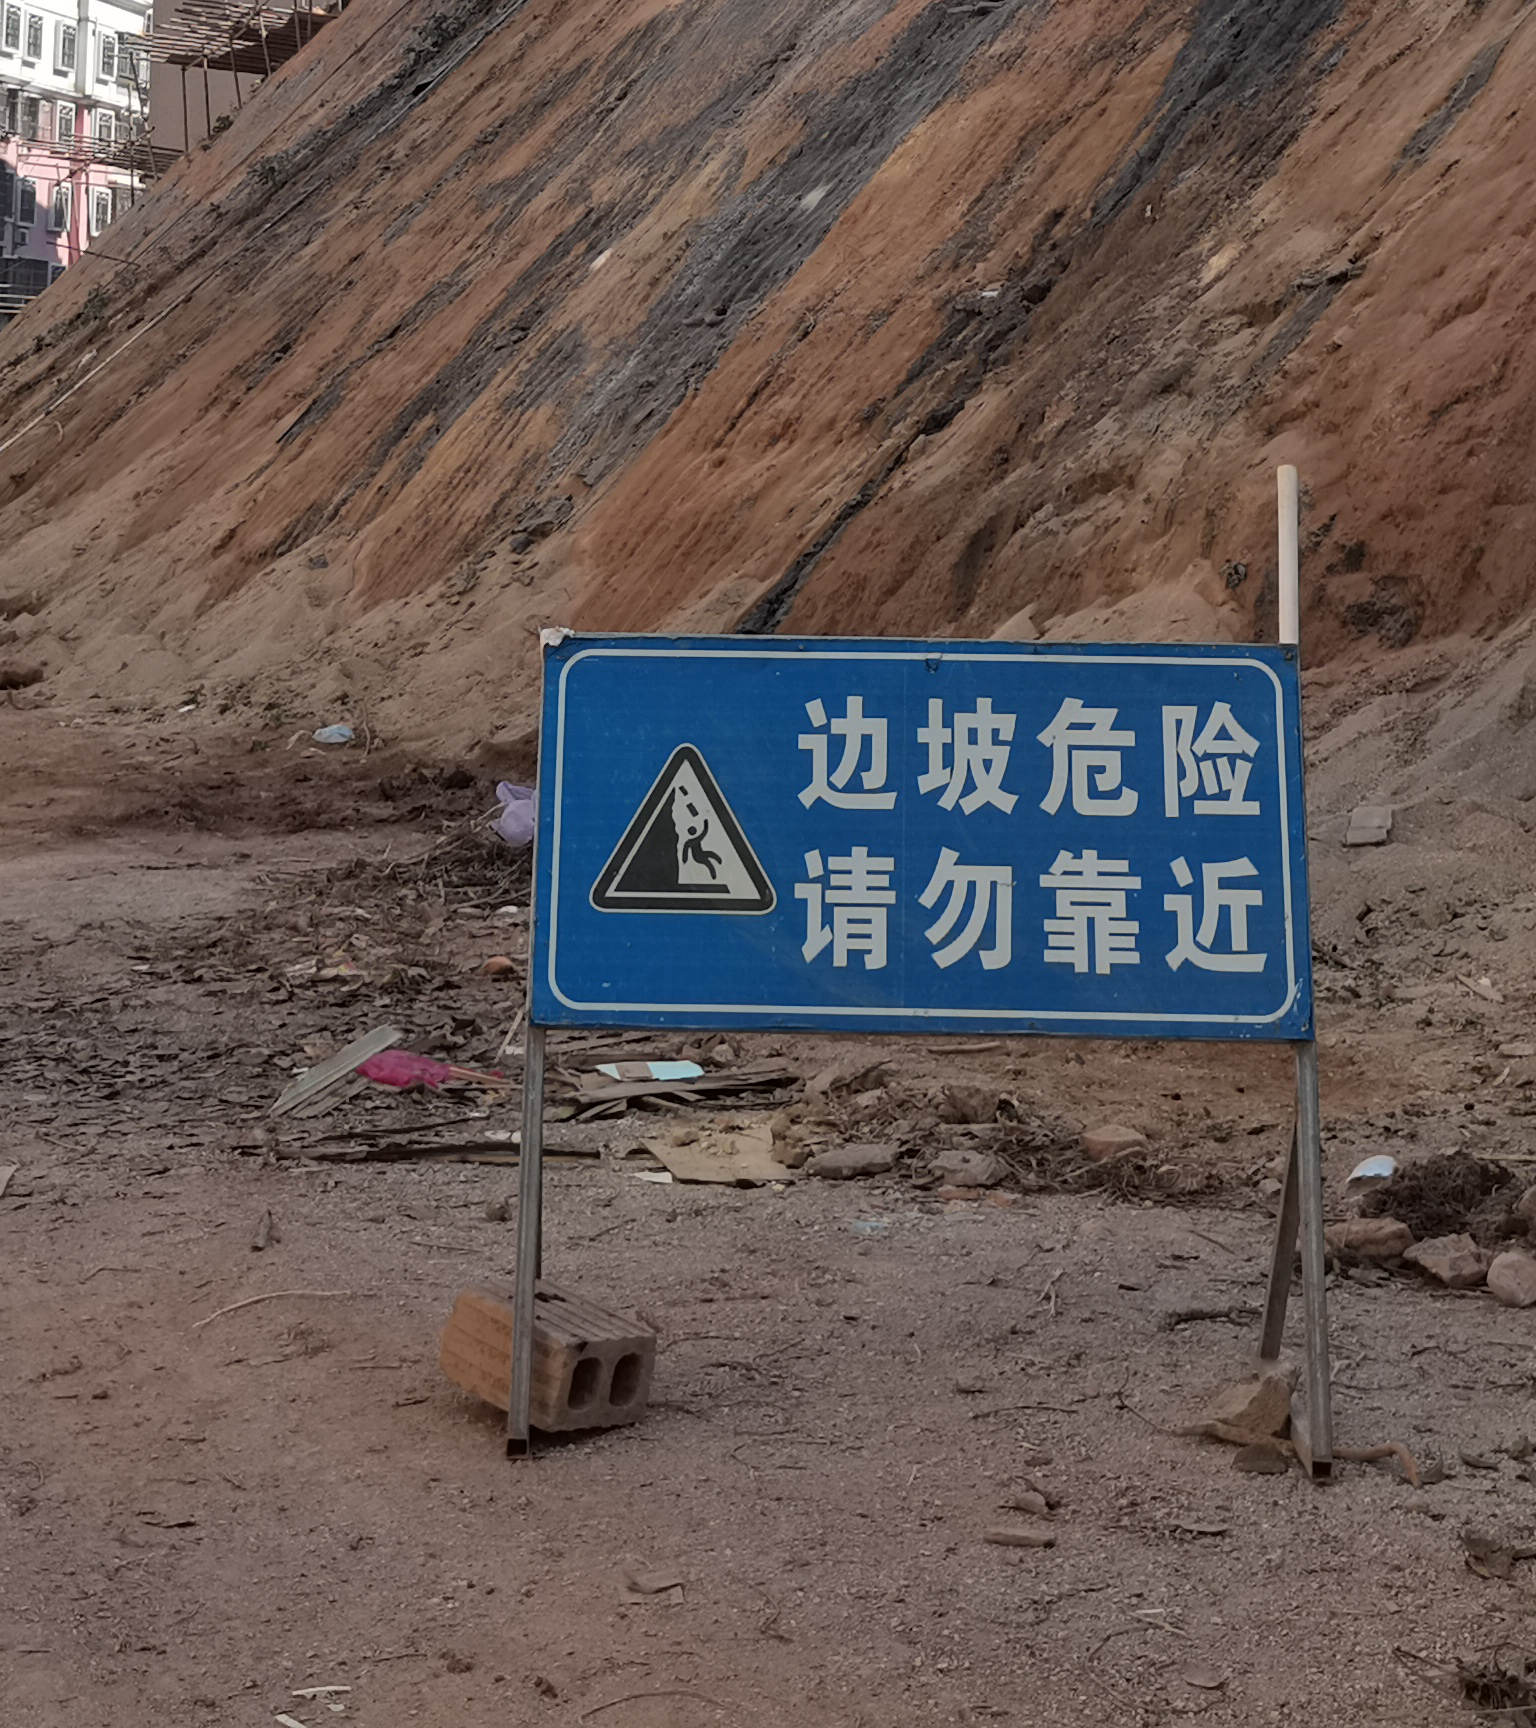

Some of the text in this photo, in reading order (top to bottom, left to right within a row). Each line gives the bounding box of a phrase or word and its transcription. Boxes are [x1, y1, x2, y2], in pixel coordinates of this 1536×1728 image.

[797, 695, 1261, 818] 边坡危险
[794, 846, 1268, 974] 请勿靠近
